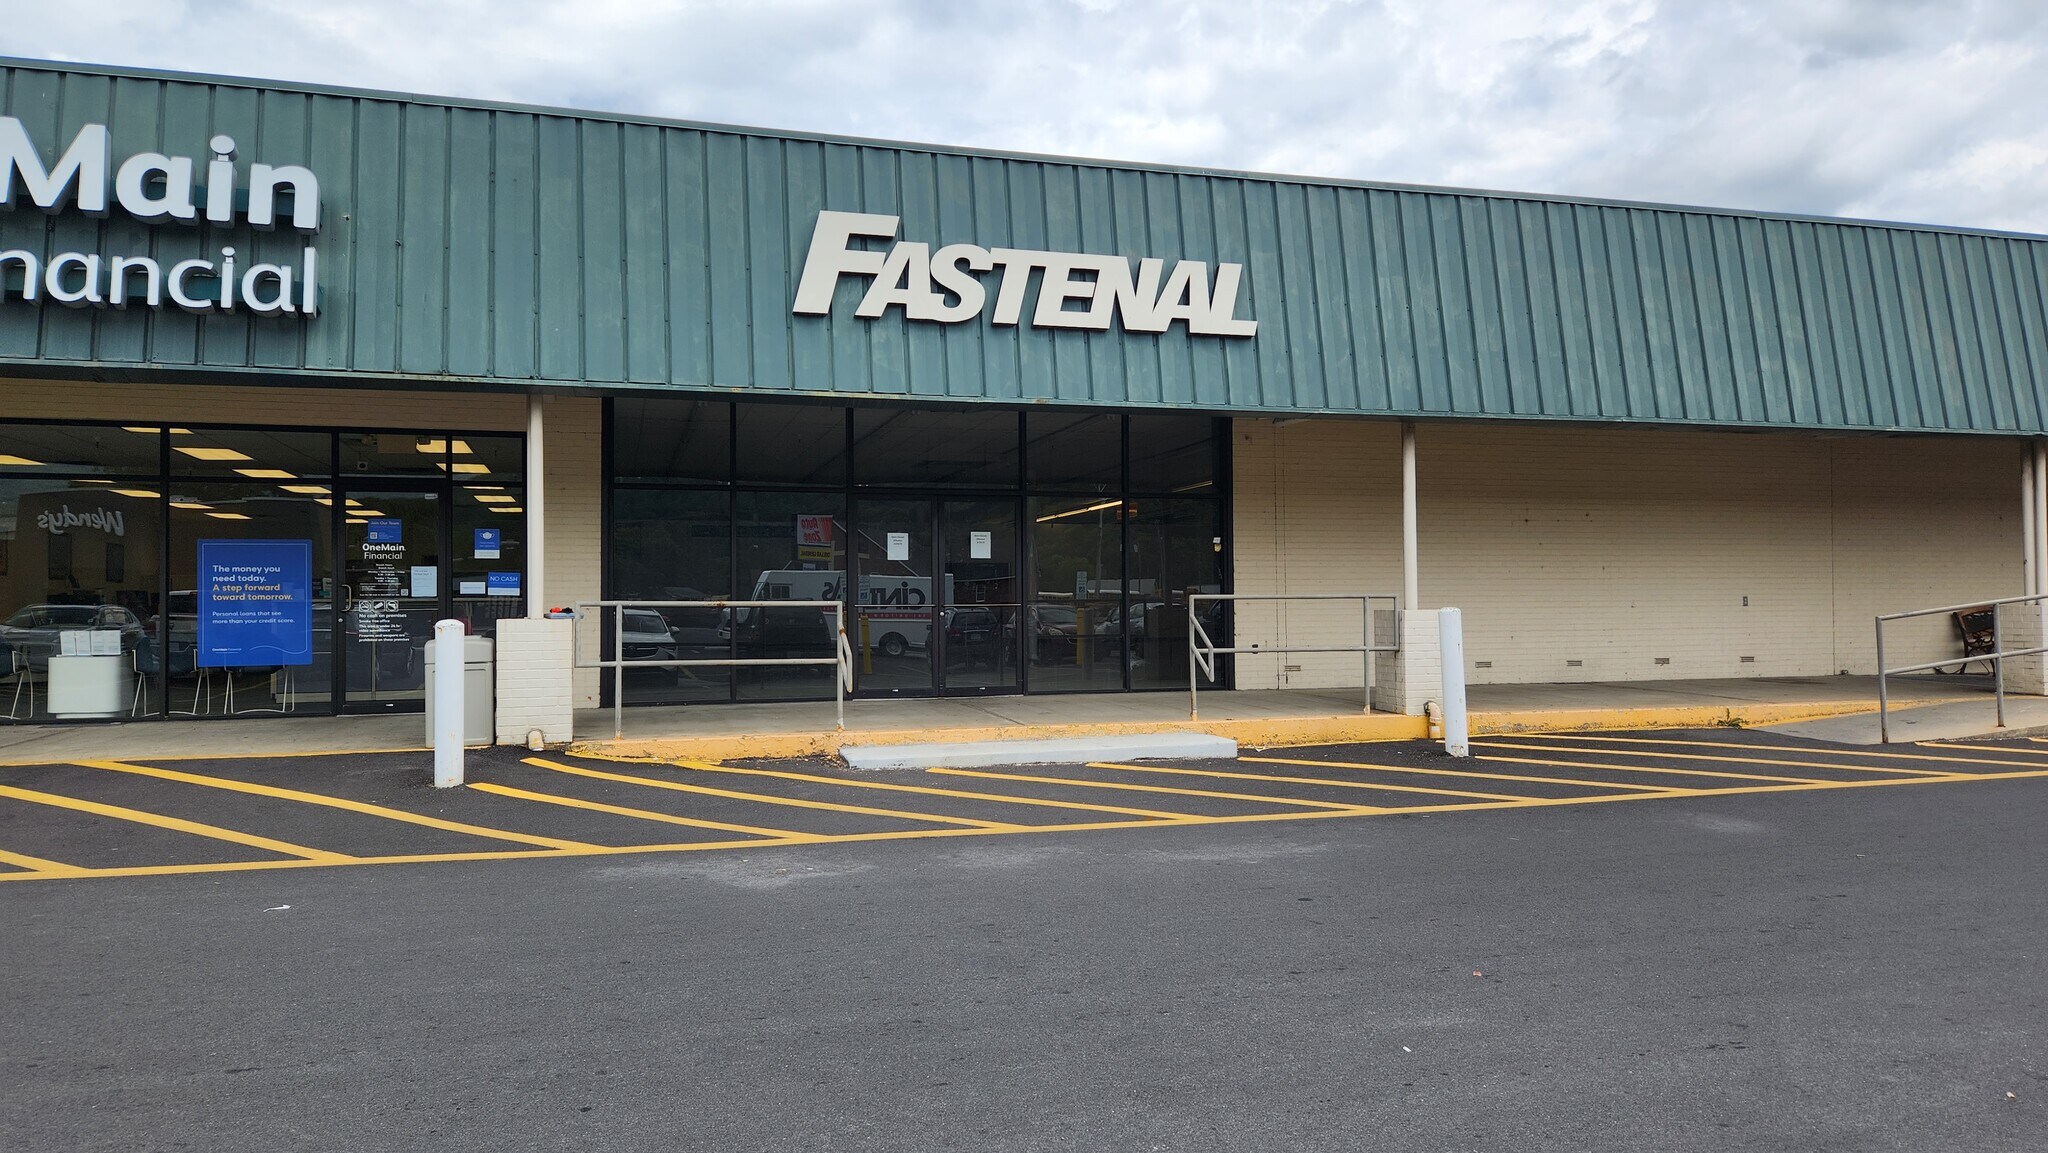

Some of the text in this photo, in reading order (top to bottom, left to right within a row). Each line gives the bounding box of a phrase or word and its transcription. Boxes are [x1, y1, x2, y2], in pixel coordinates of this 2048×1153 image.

[793, 209, 1258, 337] FASTENAL
[362, 543, 405, 551] OneMain
[364, 551, 402, 559] Financial
[231, 566, 262, 574] money
[263, 566, 281, 574] you
[212, 574, 266, 583] need today.
[222, 584, 242, 593] step
[244, 583, 281, 591] forward
